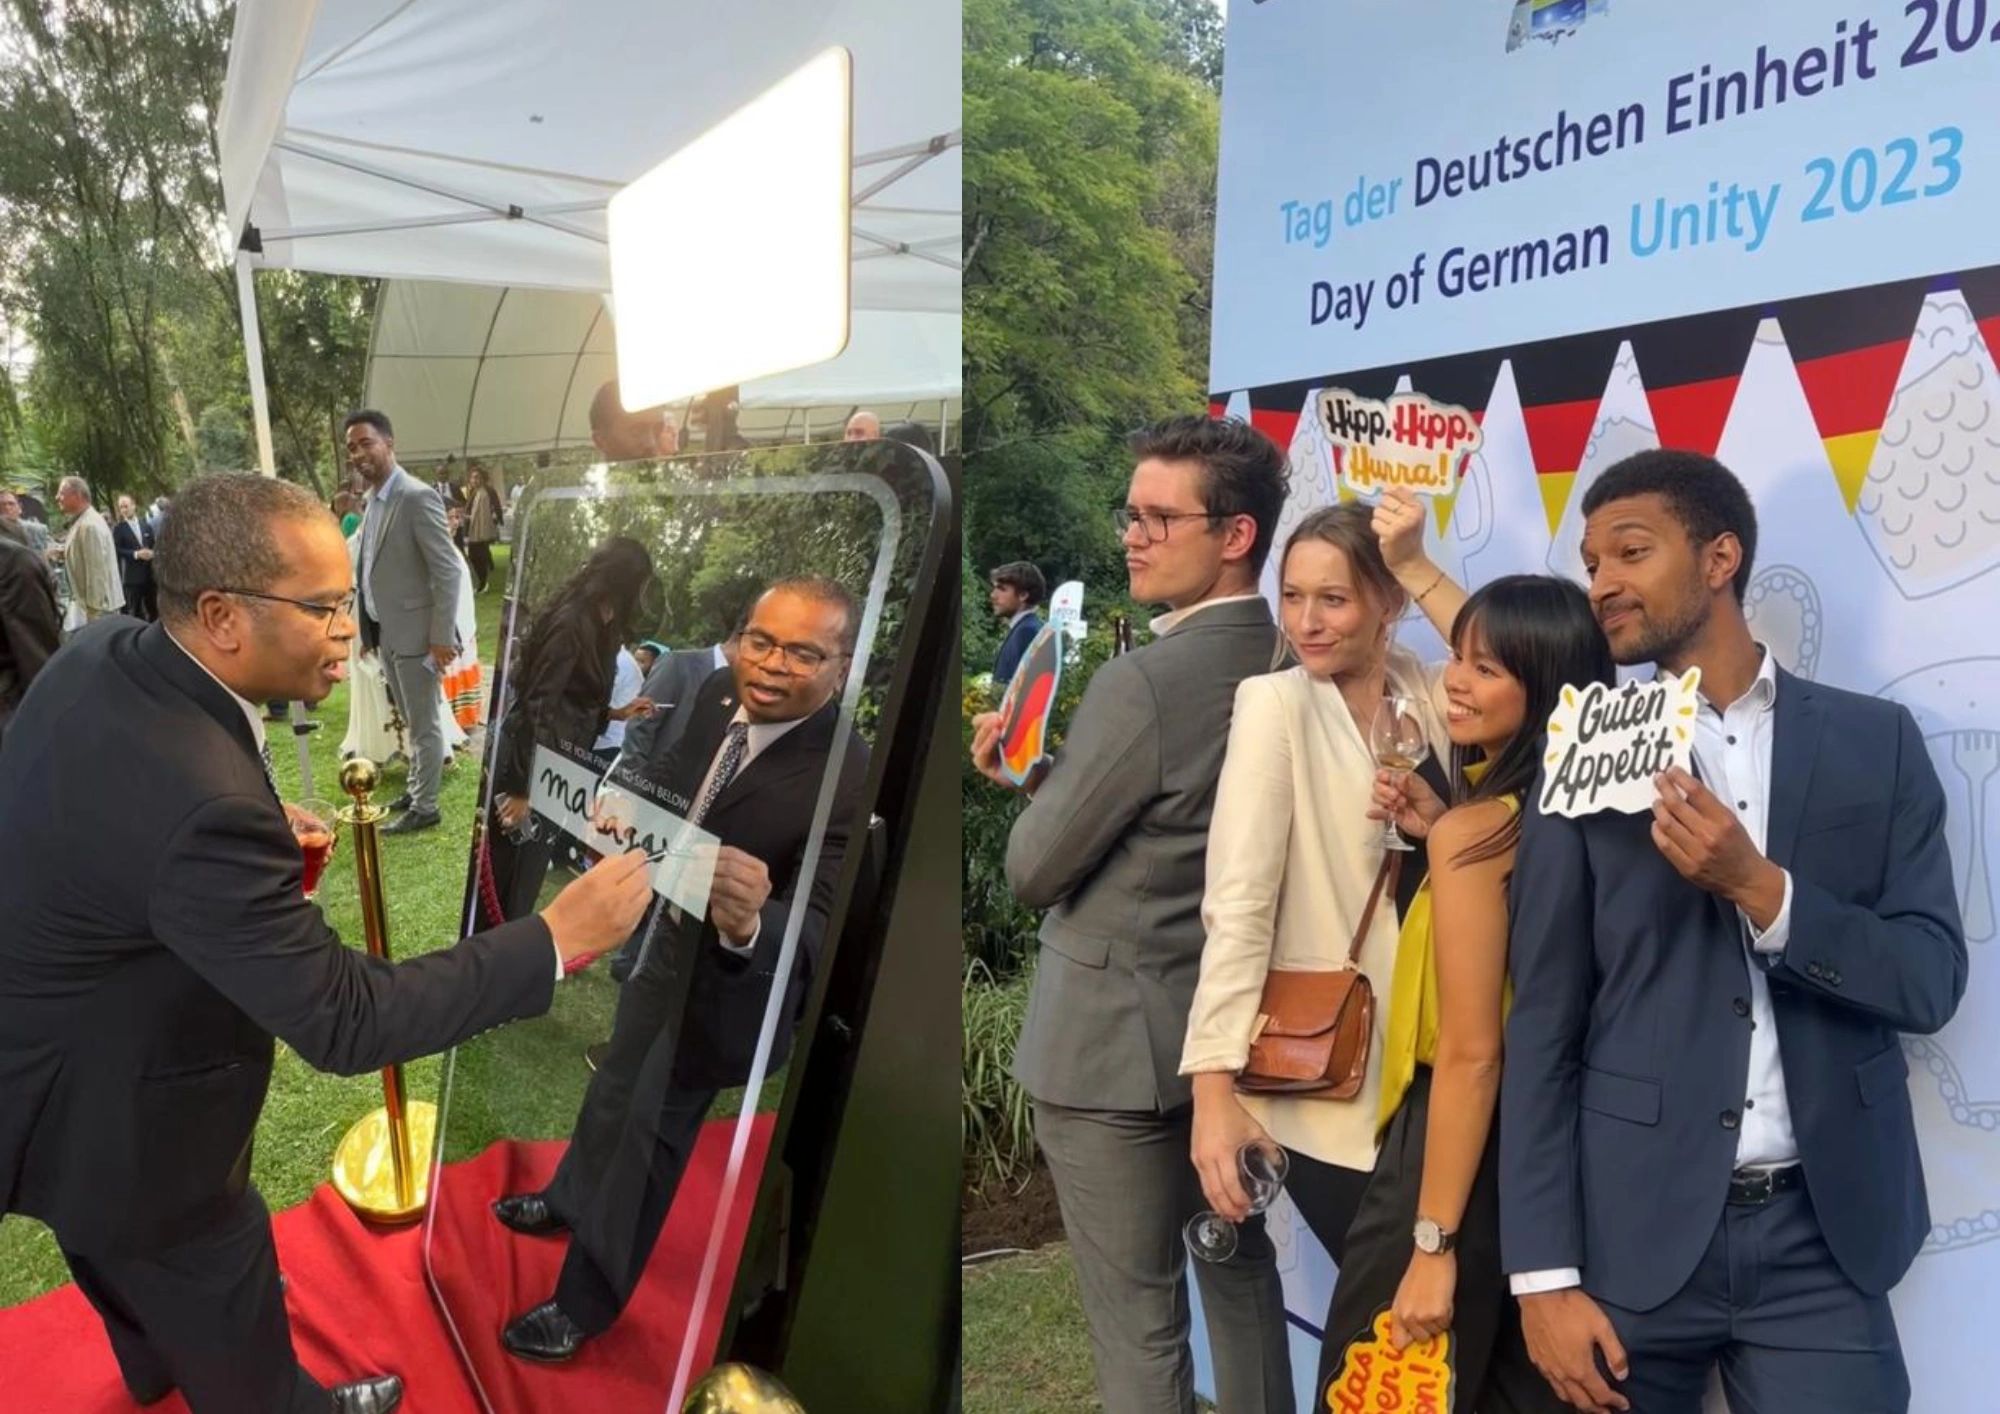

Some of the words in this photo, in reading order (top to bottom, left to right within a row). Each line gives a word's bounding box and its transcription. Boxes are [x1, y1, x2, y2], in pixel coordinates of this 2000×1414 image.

[1281, 199, 1333, 249] Tag
[1344, 176, 1402, 227] der
[1414, 101, 1645, 207] Deutschen
[1665, 18, 1878, 136] Einheit
[1900, 0, 2000, 68] 20
[1310, 280, 1376, 331] Day
[1386, 252, 1427, 310] of
[1438, 223, 1610, 299] German
[1629, 181, 1782, 257] Unity
[1801, 125, 1964, 223] 2023
[1350, 446, 1448, 487] Hurra!
[1578, 679, 1667, 745] Guten
[634, 774, 655, 795] SIGN
[656, 784, 691, 812] BELOW
